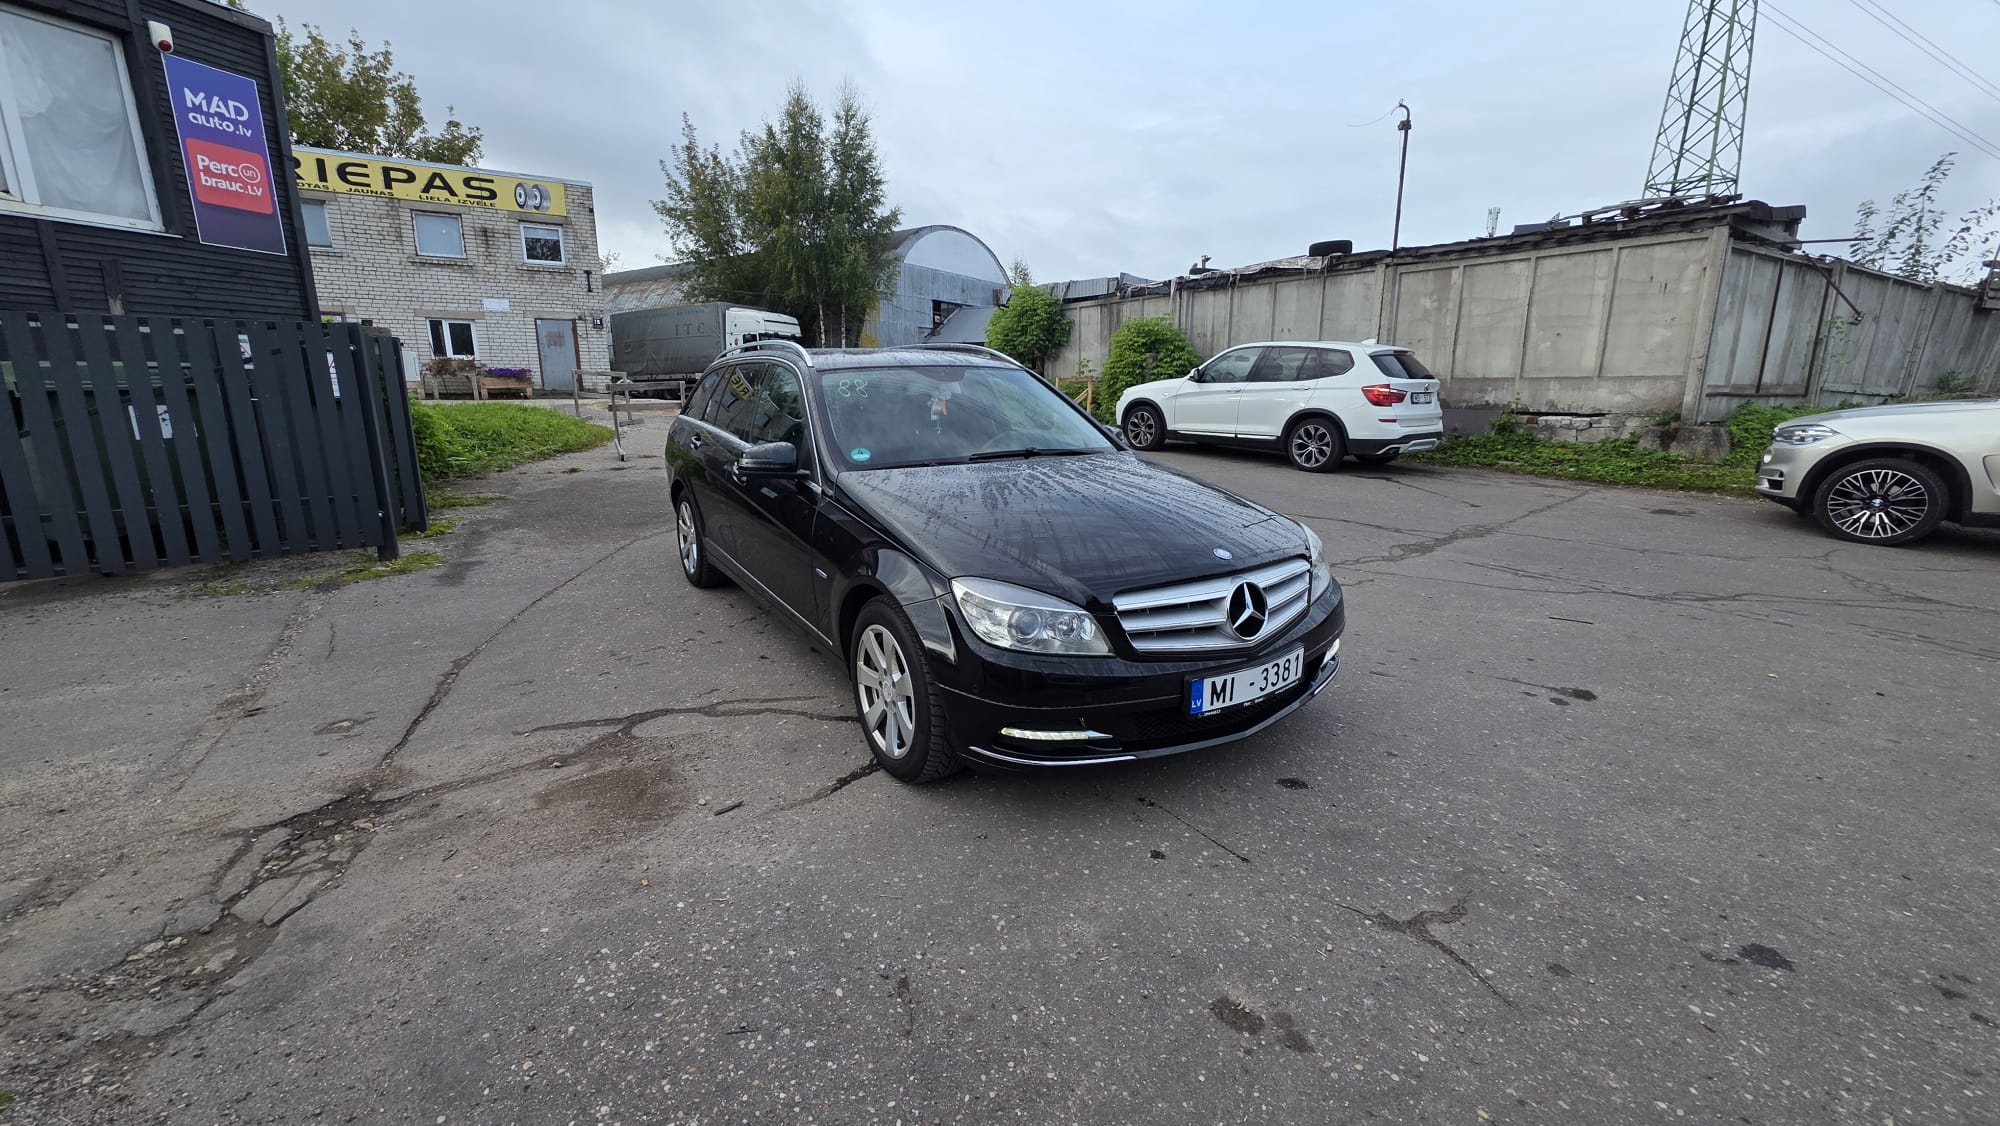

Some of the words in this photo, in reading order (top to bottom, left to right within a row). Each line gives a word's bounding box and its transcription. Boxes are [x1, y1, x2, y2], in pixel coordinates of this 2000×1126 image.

[184, 87, 249, 122] MAD
[188, 112, 252, 137] auto.lv
[196, 154, 238, 178] Perc
[244, 168, 257, 179] un
[200, 172, 263, 197] brauc.LV
[345, 187, 395, 197] JAUNAS
[839, 379, 868, 398] 88
[1191, 699, 1202, 708] LV
